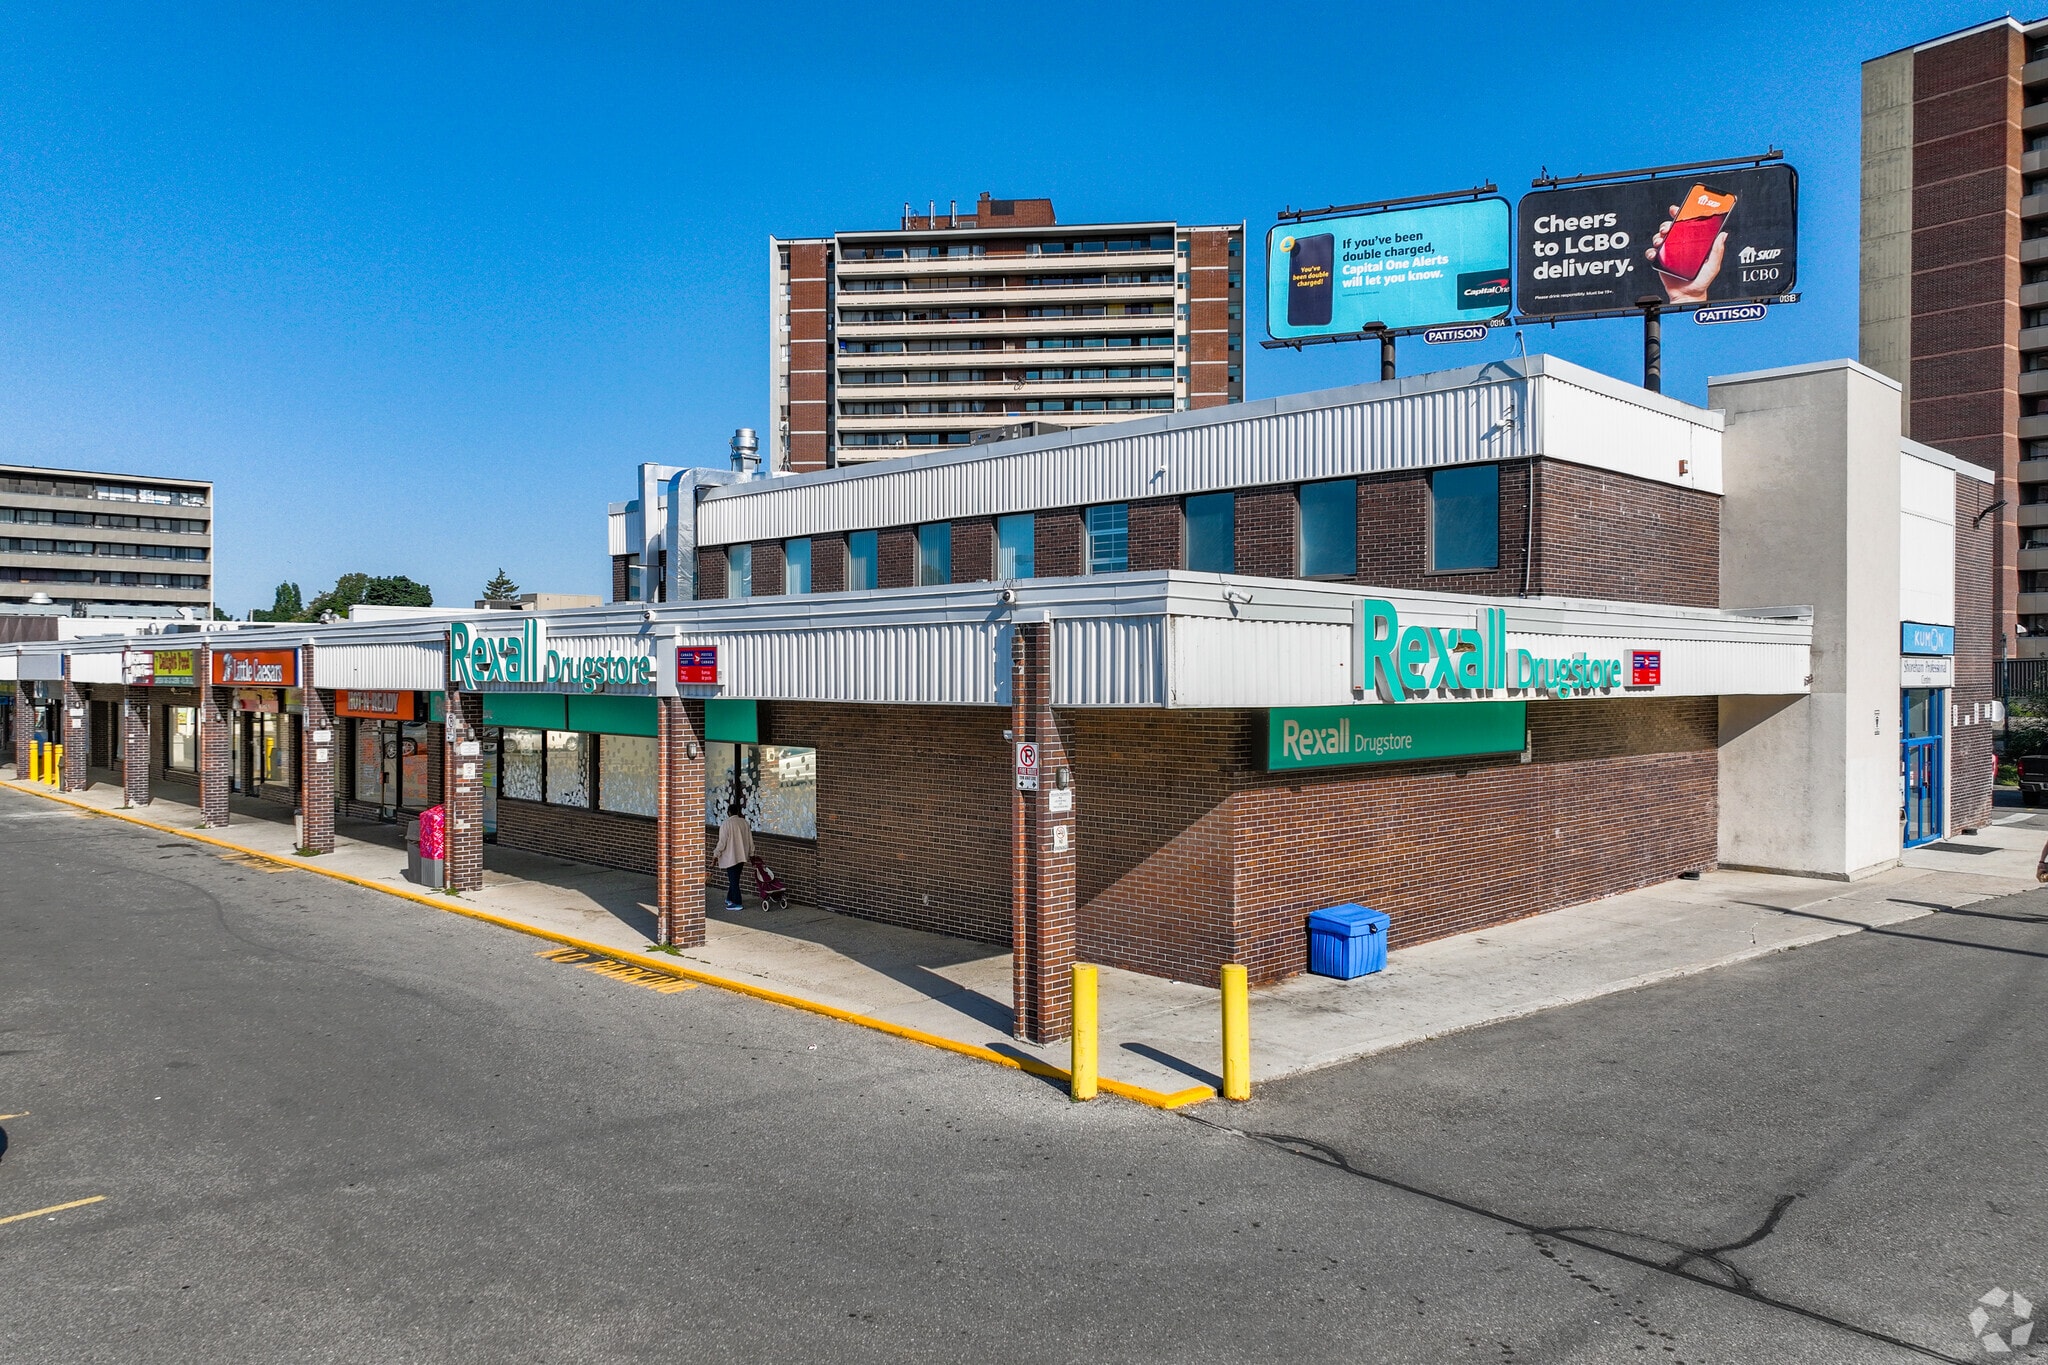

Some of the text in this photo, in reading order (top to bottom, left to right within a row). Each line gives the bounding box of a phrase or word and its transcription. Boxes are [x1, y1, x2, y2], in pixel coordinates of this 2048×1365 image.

[1533, 212, 1617, 234] Cheers
[1342, 232, 1423, 250] If you've been
[1533, 231, 1630, 257] to LCBO
[1342, 242, 1435, 262] double charged,
[1755, 248, 1782, 261] SKIP
[1307, 271, 1329, 279] double
[1342, 255, 1449, 276] Capital One Alerts
[1533, 258, 1634, 280] delivery.
[1742, 267, 1779, 283] LCBO
[1342, 269, 1444, 288] will let you know.
[1699, 306, 1761, 321] PATTISON
[1428, 328, 1484, 341] PATTISON
[1362, 598, 1622, 702] Rexall Drugstore
[1914, 628, 1944, 651] KUMON
[450, 617, 652, 694] Rexall Drugstore
[232, 657, 283, 683] Little Caesars
[1282, 718, 1413, 761] Rexall Drugstore
